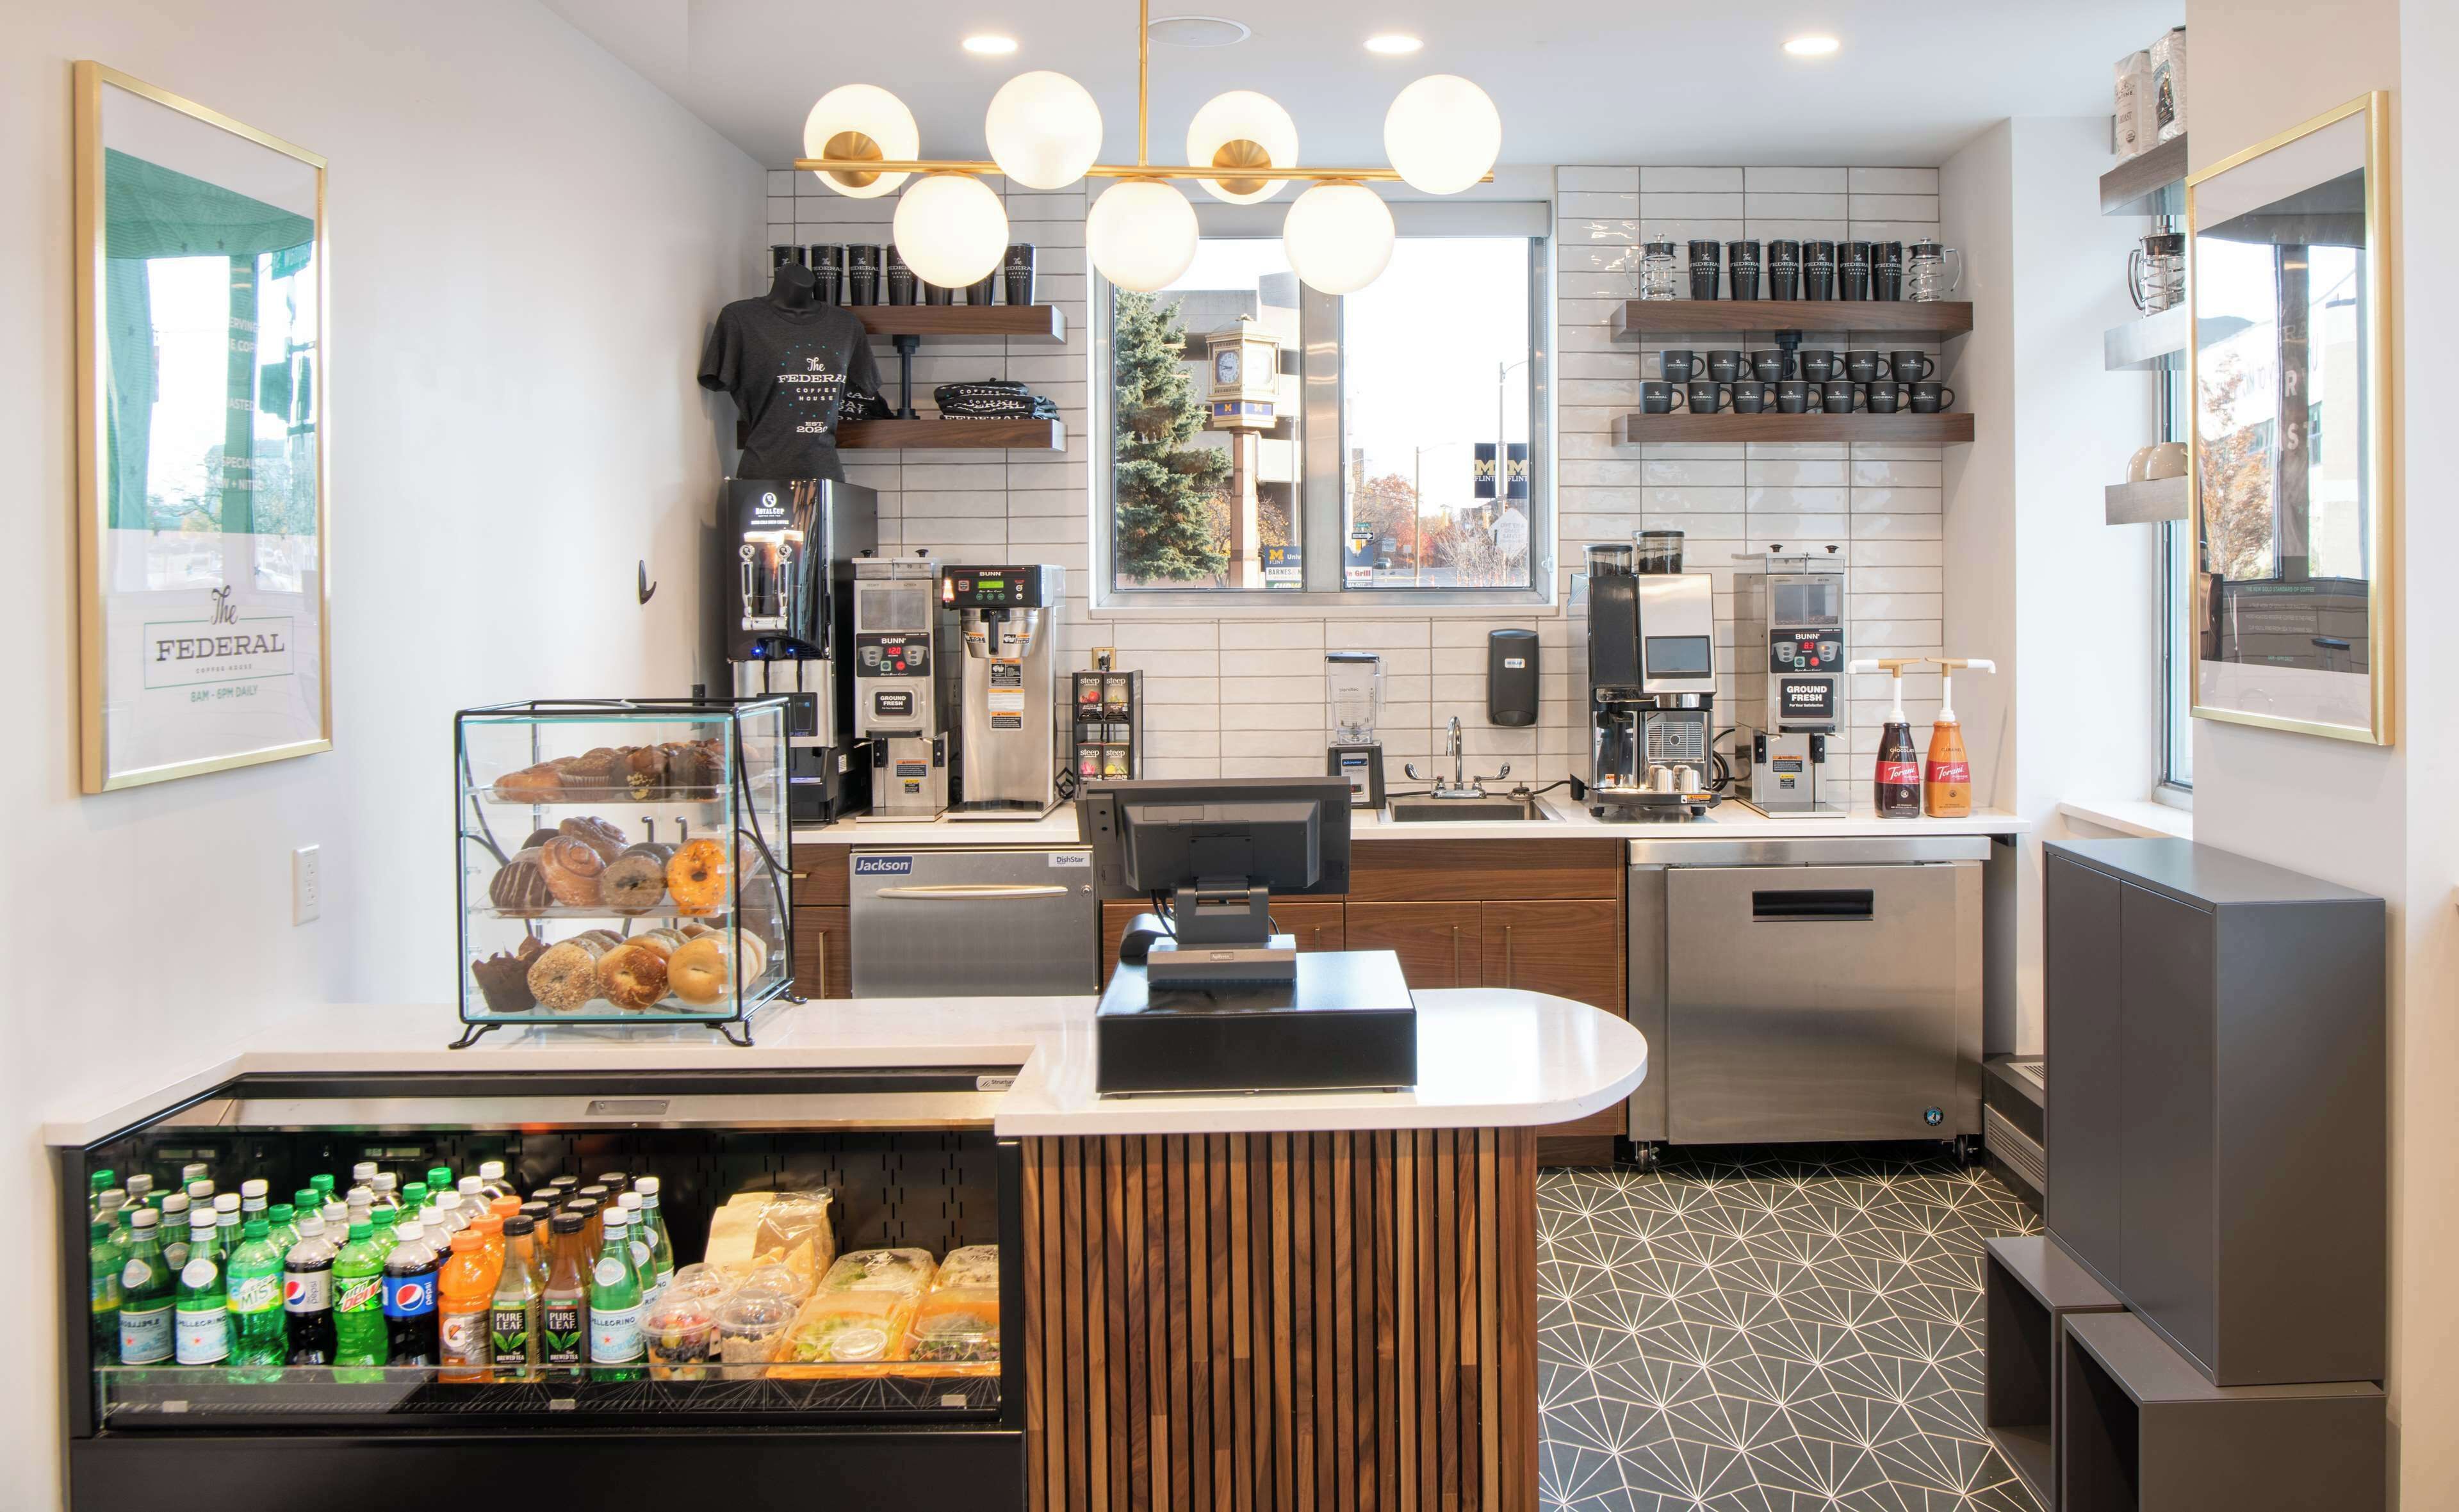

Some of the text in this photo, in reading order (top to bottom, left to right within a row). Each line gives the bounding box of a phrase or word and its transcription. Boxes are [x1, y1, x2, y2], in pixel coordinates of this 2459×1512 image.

[806, 357, 826, 371] The
[776, 374, 847, 383] FEDERAL
[211, 585, 238, 624] The
[156, 633, 285, 662] FEDERAL
[195, 665, 225, 674] COFFEE
[1106, 678, 1125, 686] steep
[236, 684, 259, 697] DAILY
[1080, 749, 1100, 758] steep
[1106, 749, 1125, 758] steep
[1888, 765, 1916, 780] Torani
[1936, 765, 1964, 779] Torani
[856, 859, 910, 872] Jackson
[1056, 856, 1085, 864] DishStar
[241, 1281, 279, 1310] MIST
[309, 1281, 319, 1305] pepsi
[424, 1281, 434, 1306] pepsi
[496, 1313, 523, 1322] PURE
[549, 1312, 576, 1321] PURE
